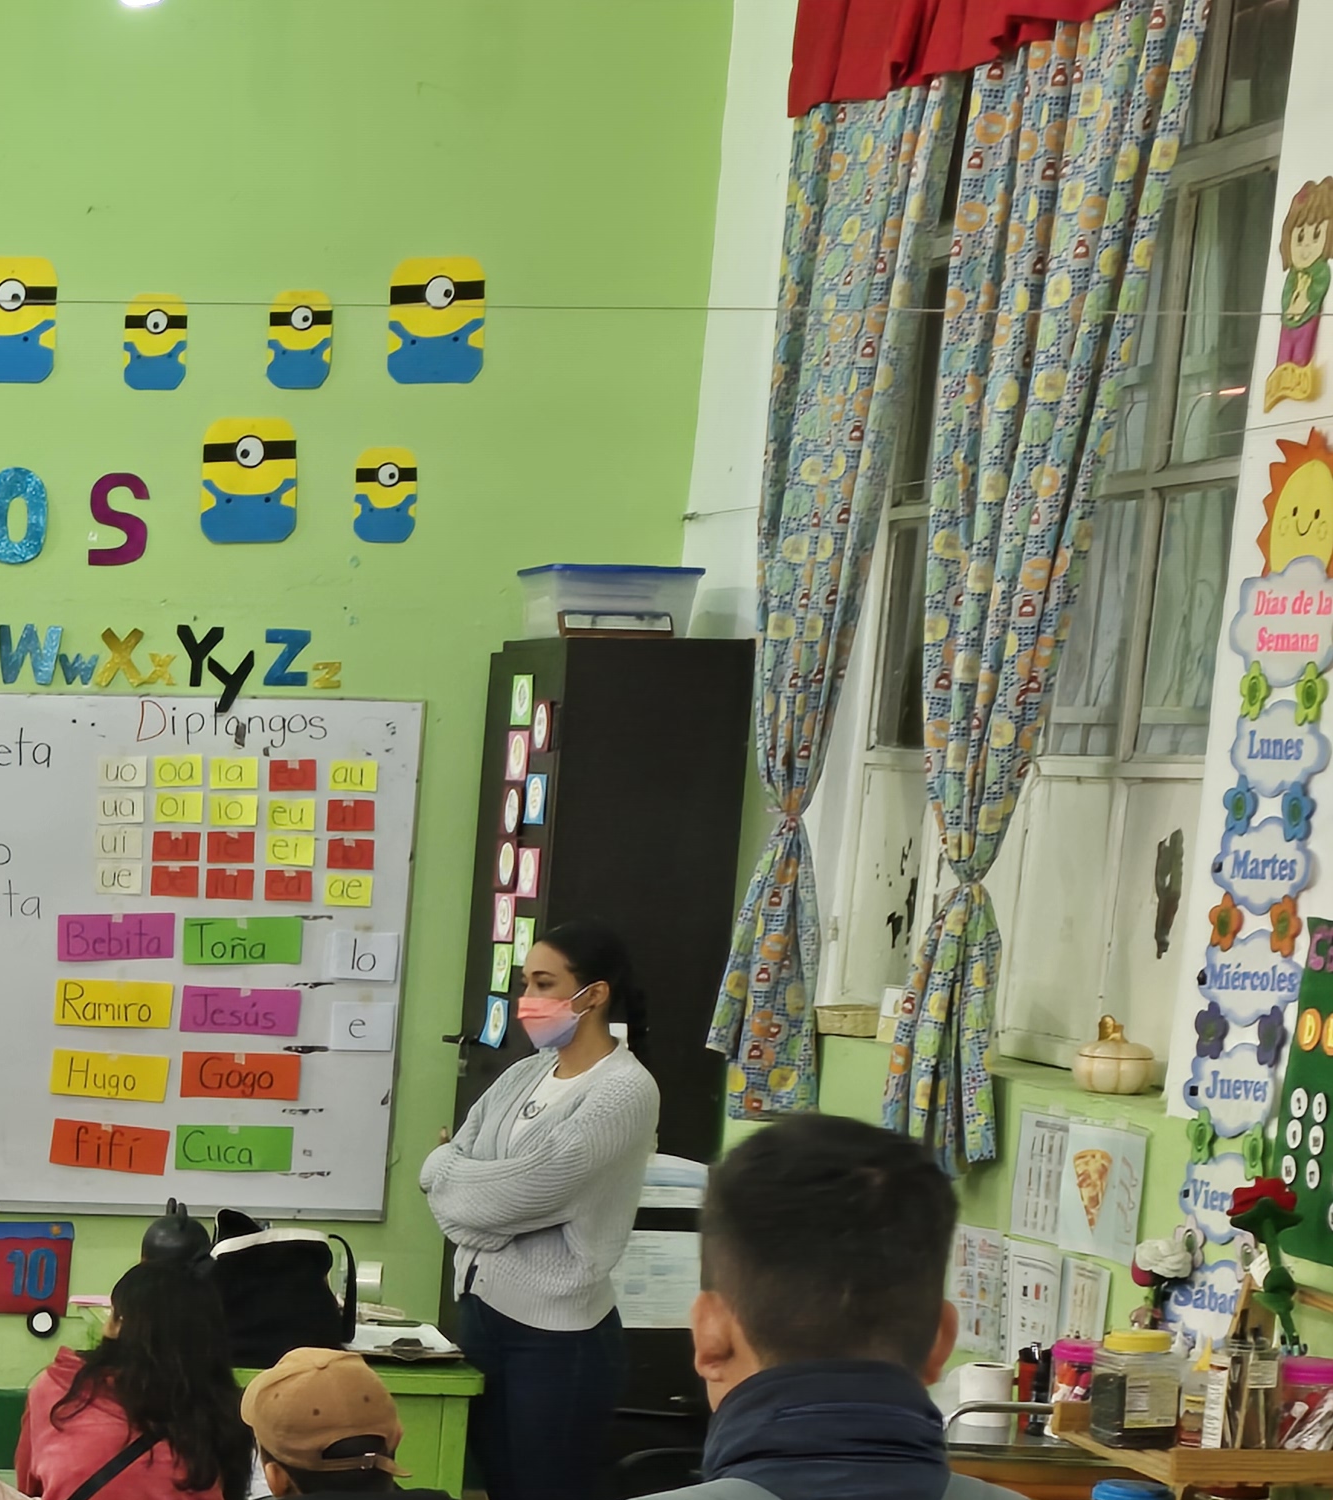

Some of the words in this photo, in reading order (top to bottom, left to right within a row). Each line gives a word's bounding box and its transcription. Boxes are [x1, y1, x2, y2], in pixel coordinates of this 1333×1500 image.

[1253, 589, 1288, 616] Días
[1291, 589, 1314, 615] de
[1316, 589, 1332, 615] la
[1257, 626, 1319, 653] Semana
[1247, 730, 1304, 762] Lunes
[105, 763, 137, 782] uo
[158, 761, 194, 782] oa
[332, 766, 364, 786] au
[271, 805, 304, 823] eu
[101, 830, 127, 854] ui
[271, 838, 299, 859] ei
[1230, 850, 1297, 882] Martes
[101, 868, 131, 888] ue
[328, 879, 362, 900] ae
[65, 920, 161, 957] Bebita
[190, 923, 266, 960] Toña
[1207, 963, 1299, 993] Miércoles
[62, 982, 152, 1023] Ramiro
[191, 992, 277, 1029] Jesús
[349, 1018, 367, 1039] e
[67, 1057, 136, 1096] Hugo
[199, 1057, 275, 1096] Gogo
[1205, 1070, 1269, 1103] Jueves
[183, 1130, 254, 1166] Cuca
[6, 1247, 58, 1300] 10
